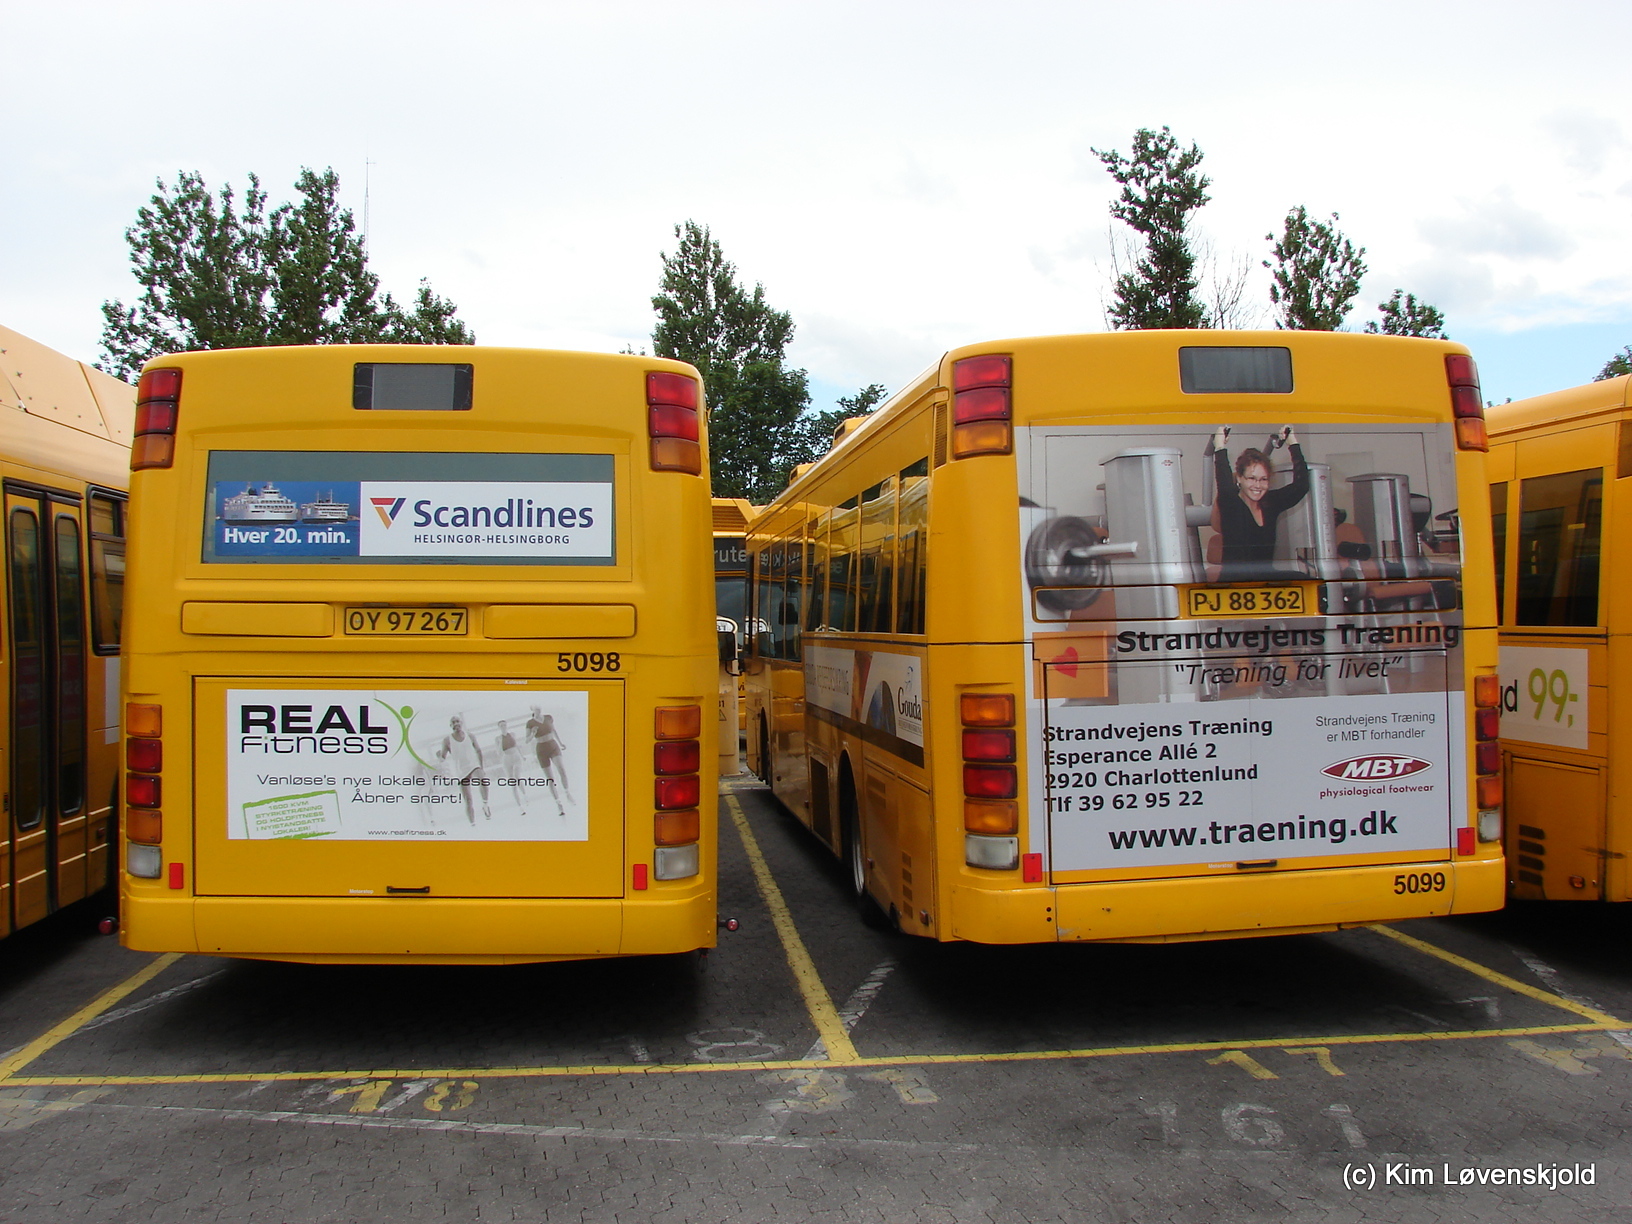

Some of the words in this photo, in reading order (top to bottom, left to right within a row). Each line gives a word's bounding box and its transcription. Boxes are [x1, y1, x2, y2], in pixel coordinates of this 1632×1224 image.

[413, 498, 594, 529] Scandlines
[224, 528, 269, 544] Hver
[274, 528, 302, 544] 20.
[308, 528, 351, 544] min.
[414, 534, 570, 545] HELSINGØR-HELSINGBORG
[1194, 592, 1220, 611] PJ
[349, 611, 381, 632] OY
[1117, 625, 1325, 654] Strandvejens
[1336, 621, 1459, 647] Træning
[557, 652, 621, 672] 5098
[1296, 660, 1331, 683] for
[897, 686, 922, 721] Gouda
[241, 704, 388, 734] REAL
[1315, 713, 1388, 727] Strandvejens
[1391, 711, 1436, 724] Træning
[1043, 722, 1183, 742] Strandvejens
[1189, 718, 1273, 736] Træning
[1326, 733, 1338, 742] er
[1341, 730, 1368, 741] MBT
[1370, 728, 1426, 740] forhandler
[241, 735, 388, 754] Fitness
[1044, 748, 1152, 769] Esperance
[1158, 742, 1198, 761] Allé
[1205, 743, 1217, 759] 2
[1045, 771, 1098, 789] 2920
[1104, 764, 1258, 787] Charlottenlund
[1340, 758, 1414, 779] MBT
[256, 774, 337, 786] Vanløse's
[342, 776, 372, 788] nye
[378, 775, 426, 786] lokale
[432, 775, 490, 787] fitness
[497, 777, 557, 787] center.
[1320, 785, 1386, 799] physiological
[1389, 784, 1435, 794] footwear
[351, 788, 405, 804] Åbner
[410, 793, 462, 804] snart!
[1078, 795, 1104, 812] 39
[1112, 793, 1138, 810] 62
[1145, 792, 1171, 808] 95
[1178, 790, 1204, 807] 22
[367, 829, 447, 837] www.realfitness.dk
[1108, 810, 1398, 850] www.traening.dk
[1393, 872, 1446, 895] 5099
